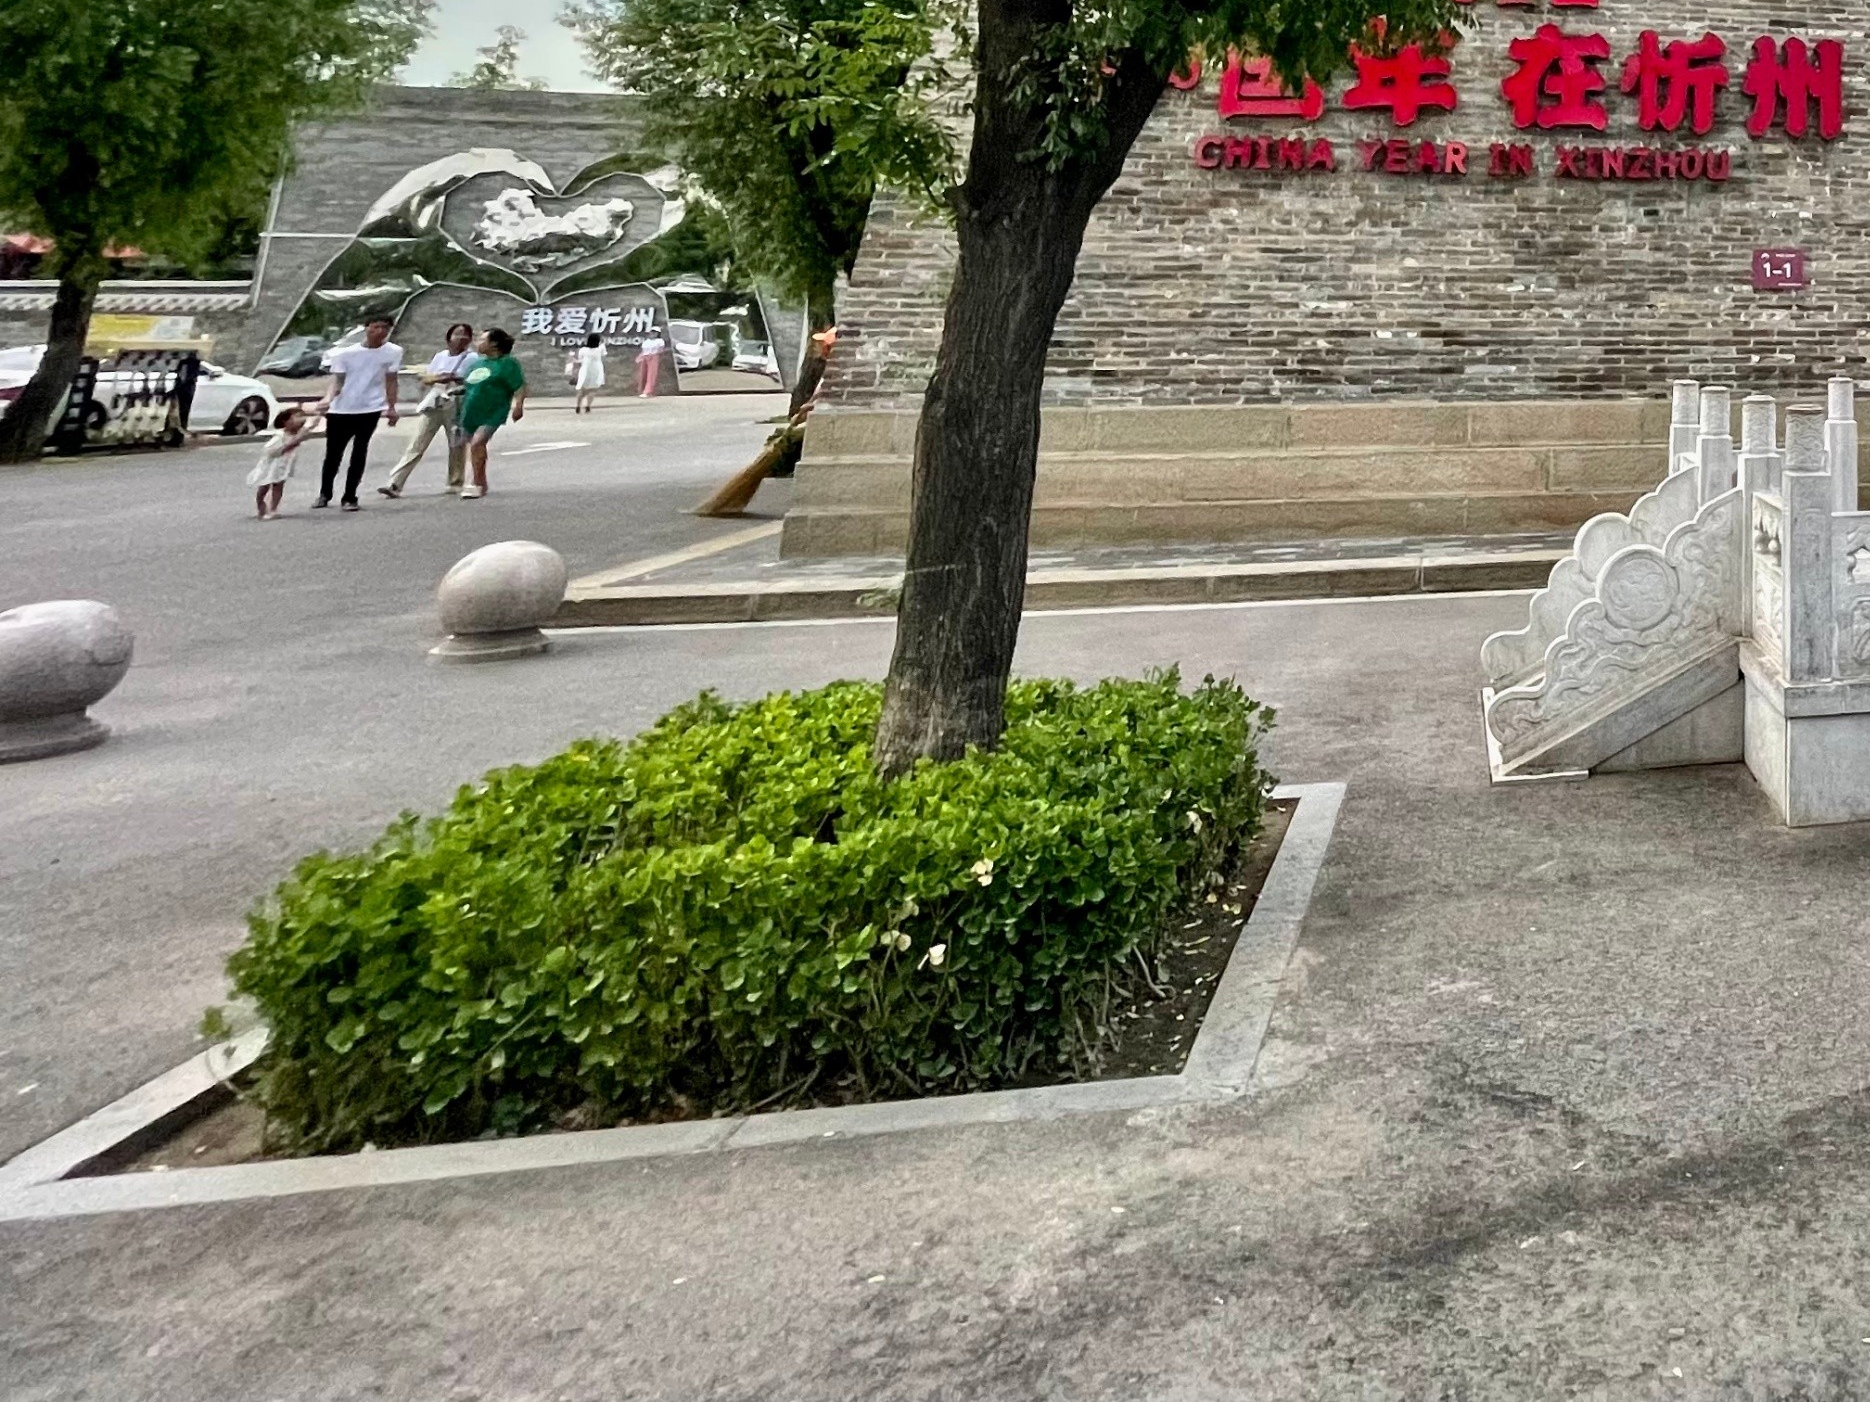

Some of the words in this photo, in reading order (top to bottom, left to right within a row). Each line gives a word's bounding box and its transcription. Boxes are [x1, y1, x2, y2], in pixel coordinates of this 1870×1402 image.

[1195, 135, 1334, 172] CHINA
[1356, 138, 1467, 175] YEAR
[1488, 143, 1534, 178] IN
[1553, 145, 1732, 181] XINZHOU
[1763, 262, 1791, 279] 1-1
[521, 307, 657, 335] 我爱忻州
[560, 337, 590, 346] LOV
